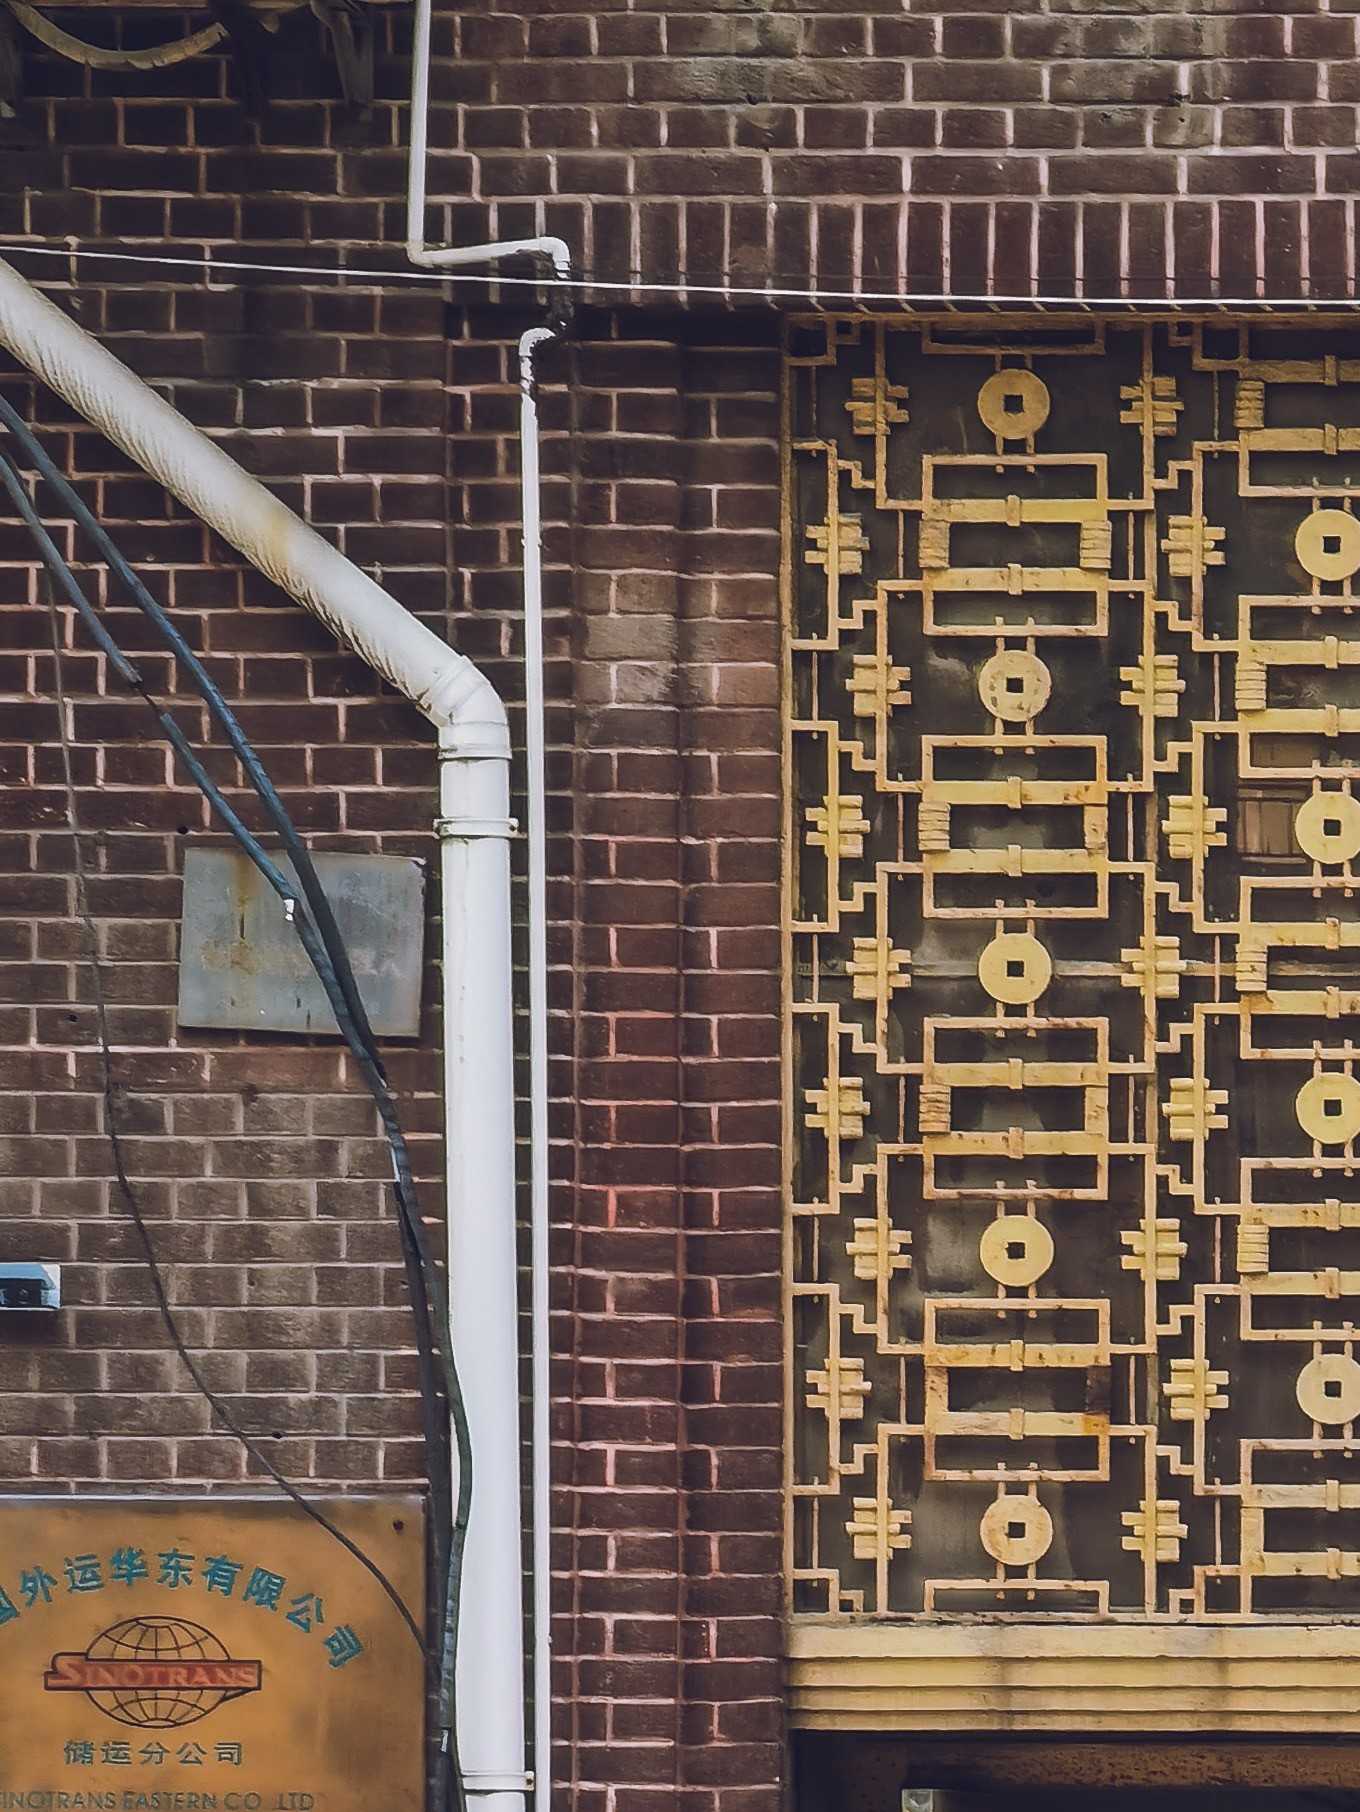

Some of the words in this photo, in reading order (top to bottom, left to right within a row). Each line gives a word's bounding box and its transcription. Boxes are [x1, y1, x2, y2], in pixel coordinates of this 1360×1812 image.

[47, 1658, 255, 1687] SINOTRANS
[64, 1740, 243, 1766] 储运分公司
